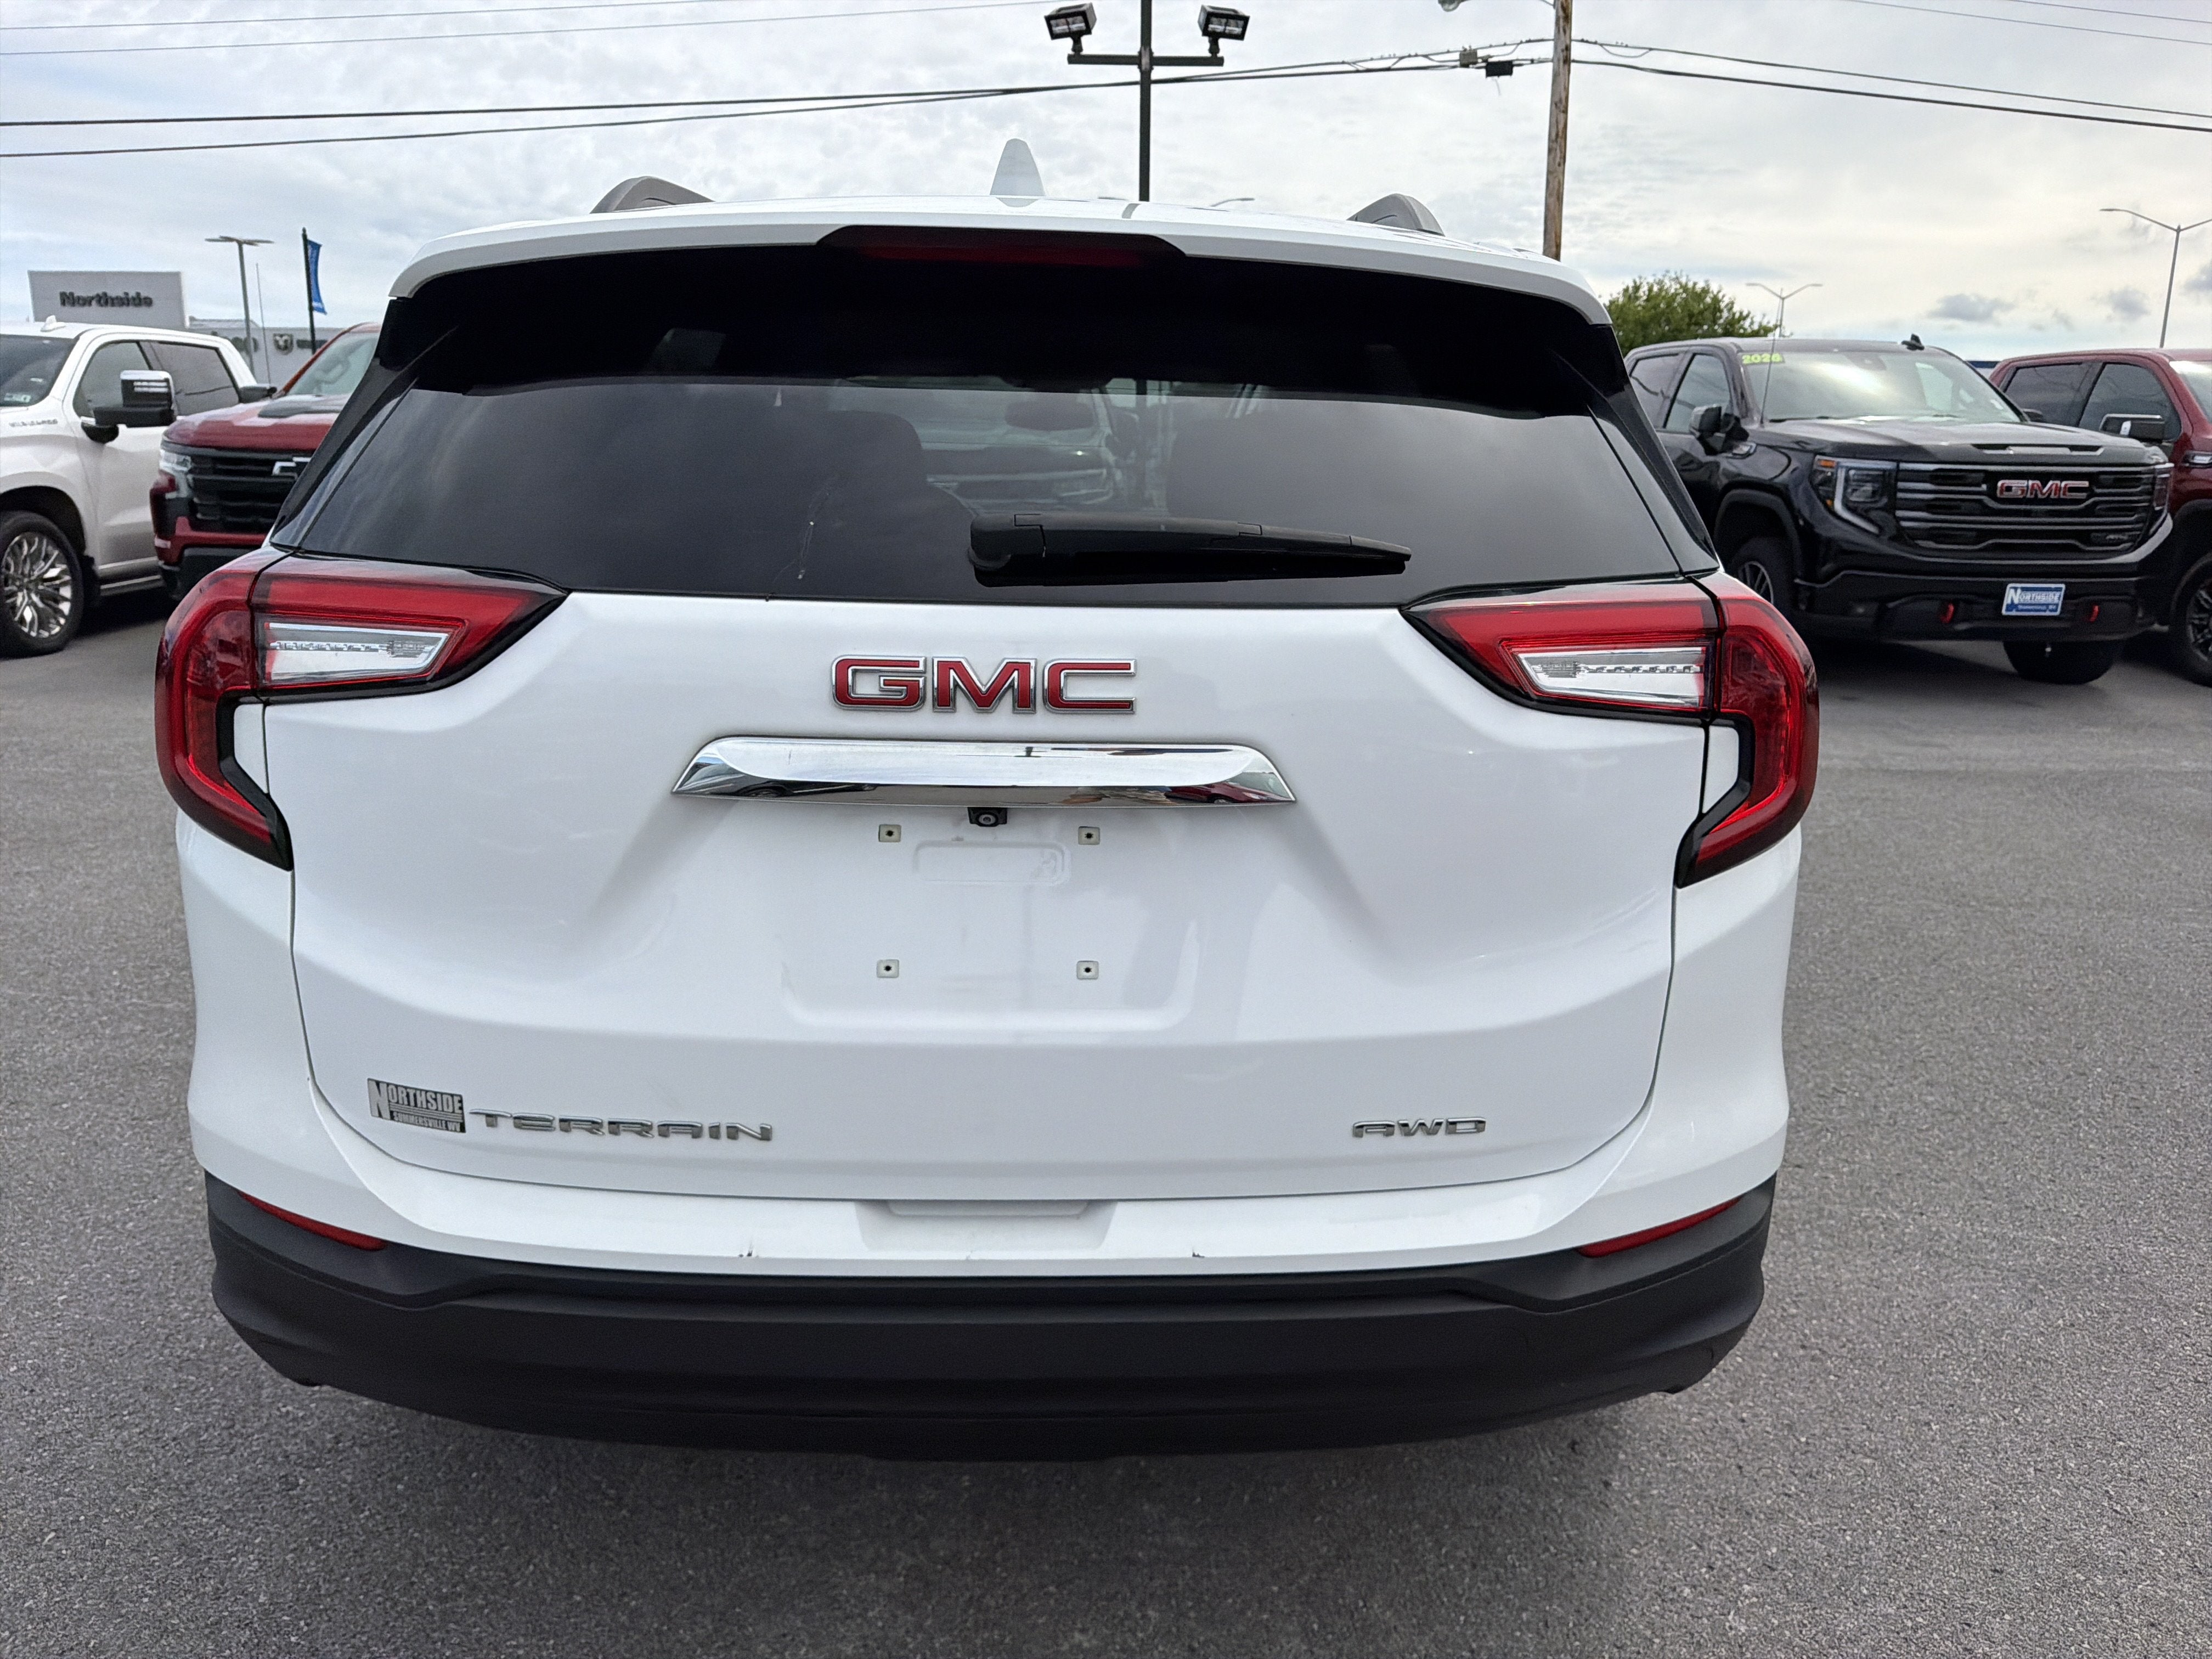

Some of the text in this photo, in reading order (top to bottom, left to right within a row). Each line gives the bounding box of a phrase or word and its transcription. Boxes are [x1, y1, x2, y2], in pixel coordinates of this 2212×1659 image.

[59, 291, 153, 307] Northside
[1997, 479, 2089, 499] GMC
[2007, 588, 2061, 604] NORTHSIDE
[831, 654, 1136, 713] GMC
[368, 1080, 462, 1120] NORTHSIDE
[393, 1111, 461, 1132] SUMMERSVILLE WV
[470, 1108, 772, 1141] TERRAIN
[1352, 1116, 1486, 1138] AWD
